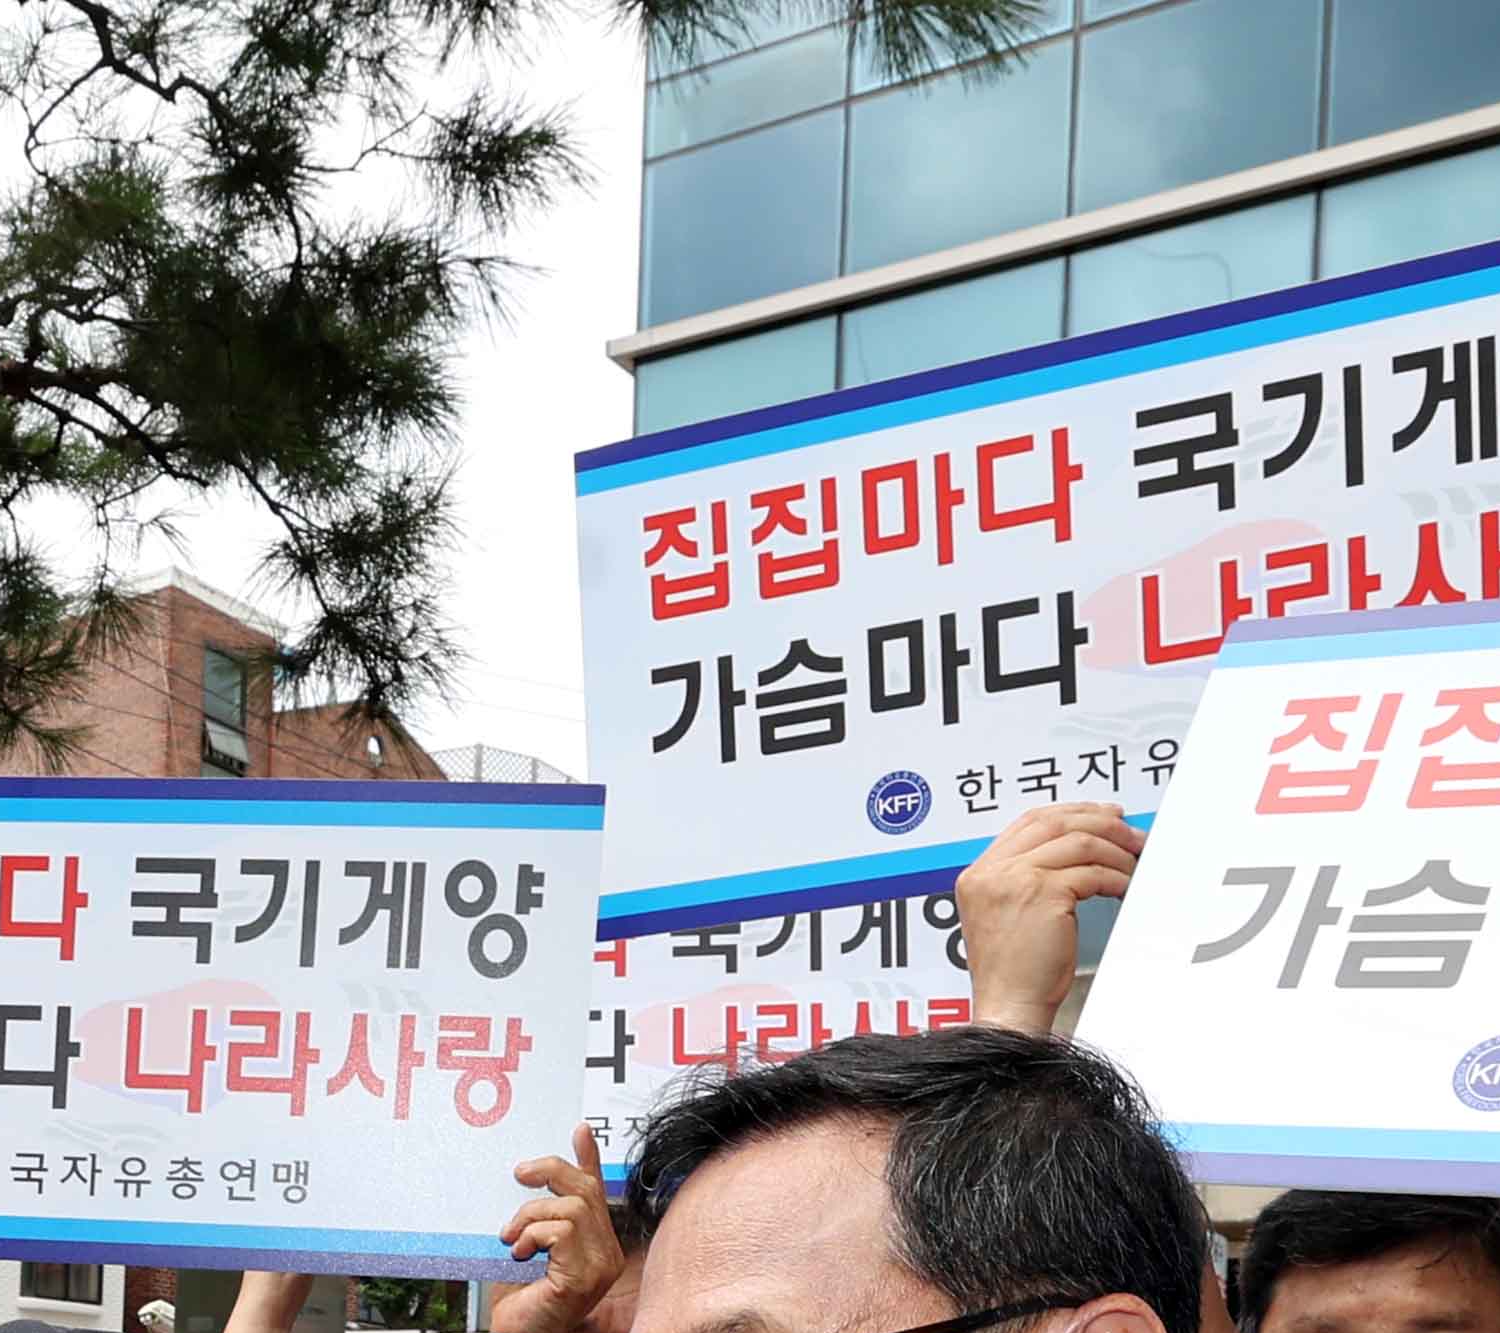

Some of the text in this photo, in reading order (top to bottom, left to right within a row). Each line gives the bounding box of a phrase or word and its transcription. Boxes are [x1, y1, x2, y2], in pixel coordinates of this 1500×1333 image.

[642, 426, 1083, 621] 집집마다
[650, 590, 1090, 764] 가슴마다
[879, 792, 920, 815] KFF
[131, 857, 545, 980] 국기게양
[125, 1006, 534, 1128] 나라사랑
